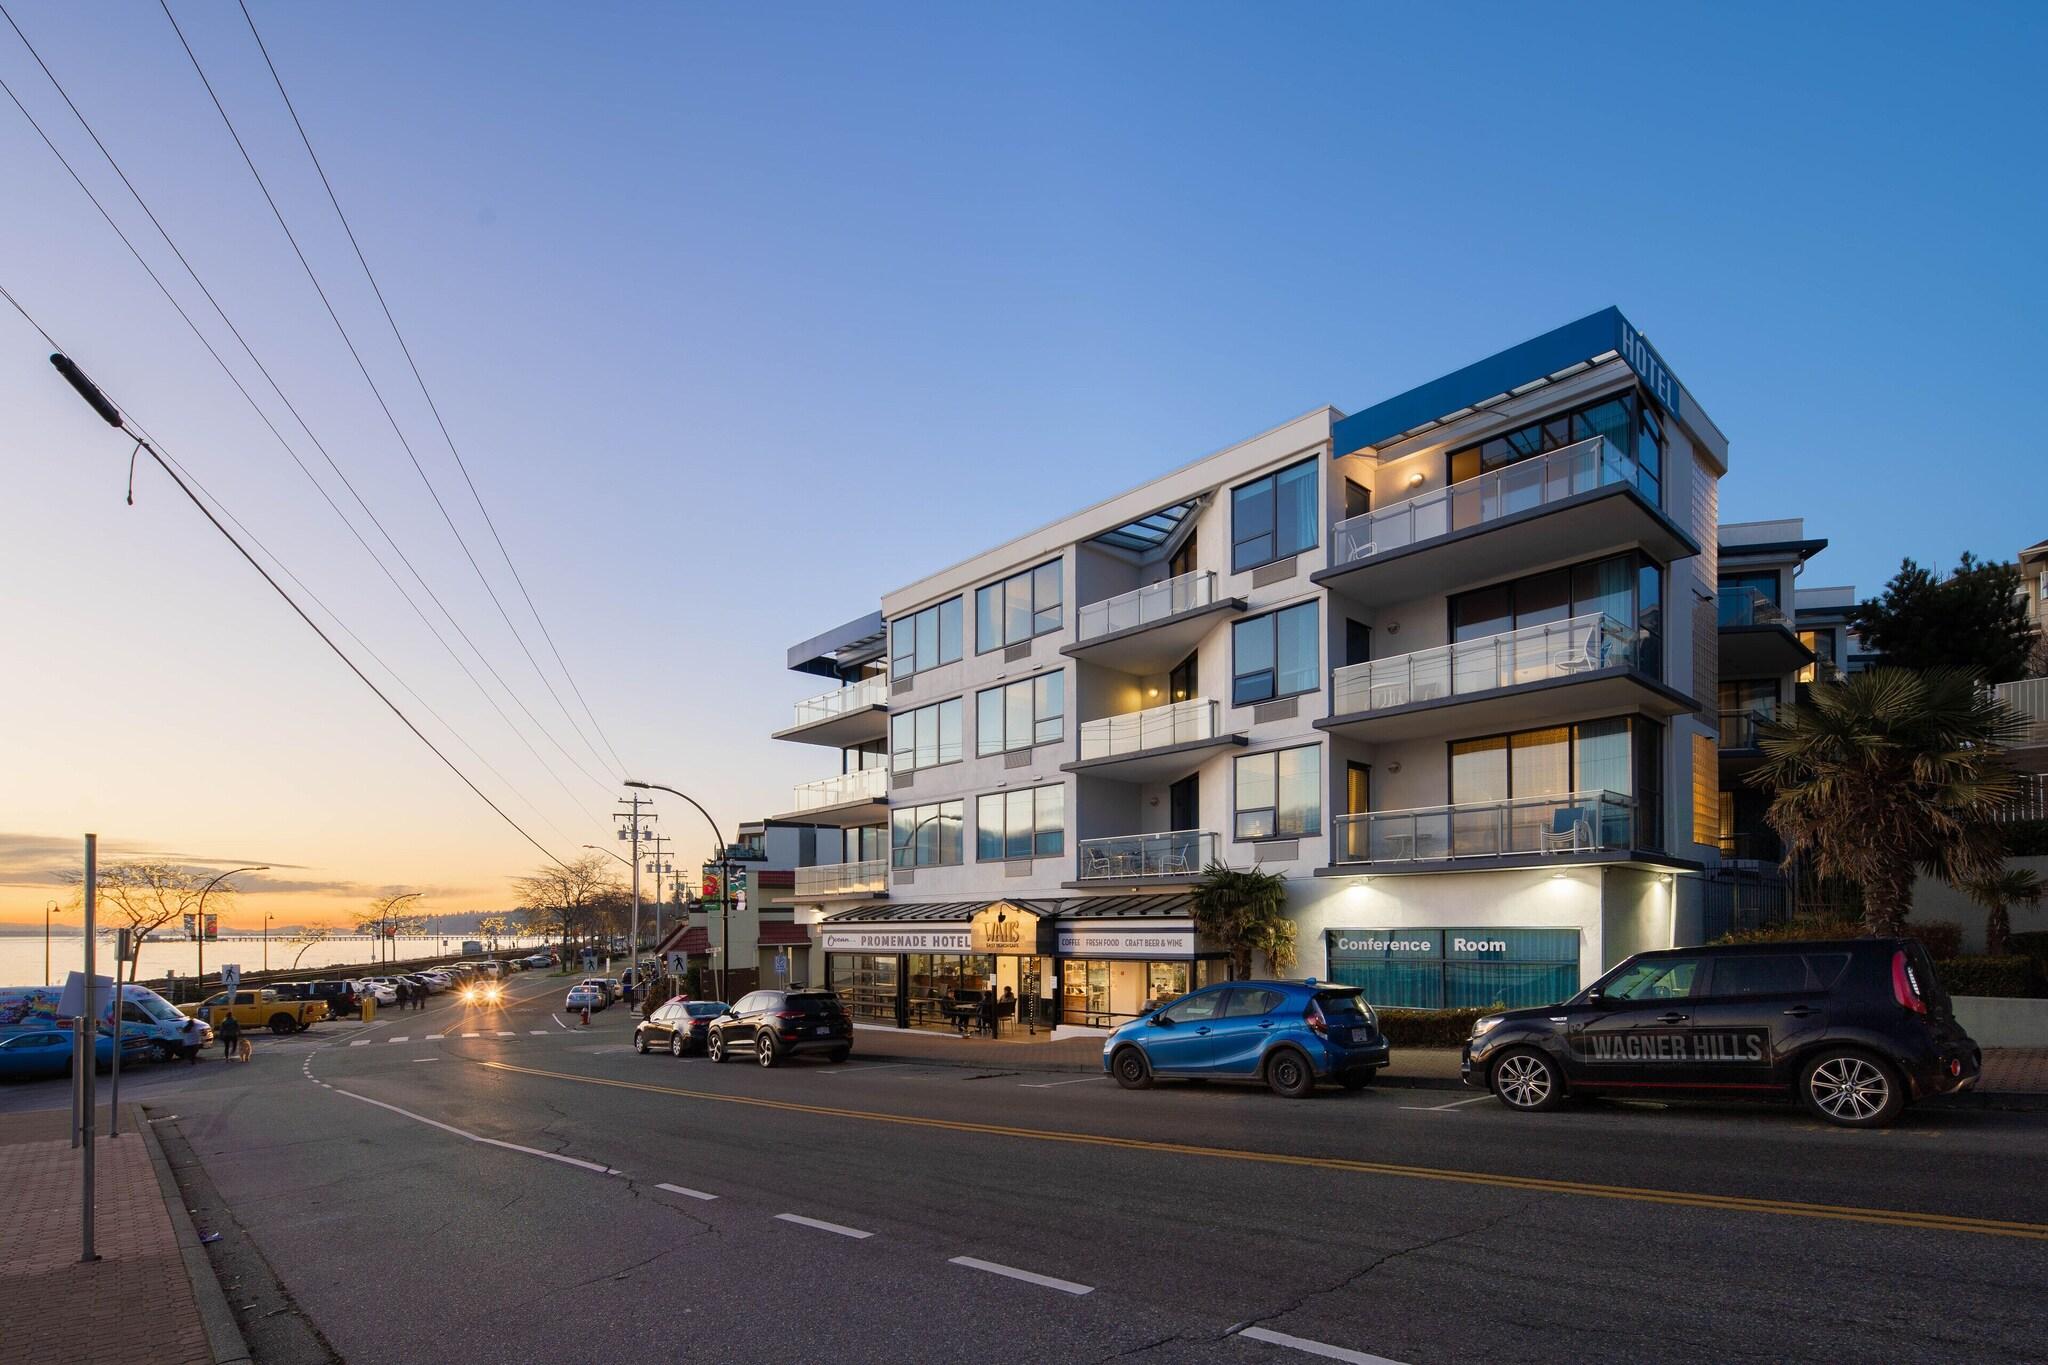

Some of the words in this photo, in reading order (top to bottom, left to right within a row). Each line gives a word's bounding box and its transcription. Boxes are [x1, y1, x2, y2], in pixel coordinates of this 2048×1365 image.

[1622, 321, 1675, 413] HOTEL
[860, 935, 927, 947] PROMENADE
[932, 935, 971, 948] HOTEL
[1061, 938, 1081, 947] COFFEE
[1085, 938, 1103, 947] FRESH
[1103, 938, 1120, 947] FOOD
[1124, 938, 1143, 947] CRAFT
[1144, 938, 1160, 947] BEER
[1166, 938, 1183, 948] WINE
[1337, 937, 1432, 952] Conference
[1453, 937, 1506, 952] Room
[1591, 1035, 1687, 1061] WAGNER
[1693, 1034, 1762, 1062] HILLS
